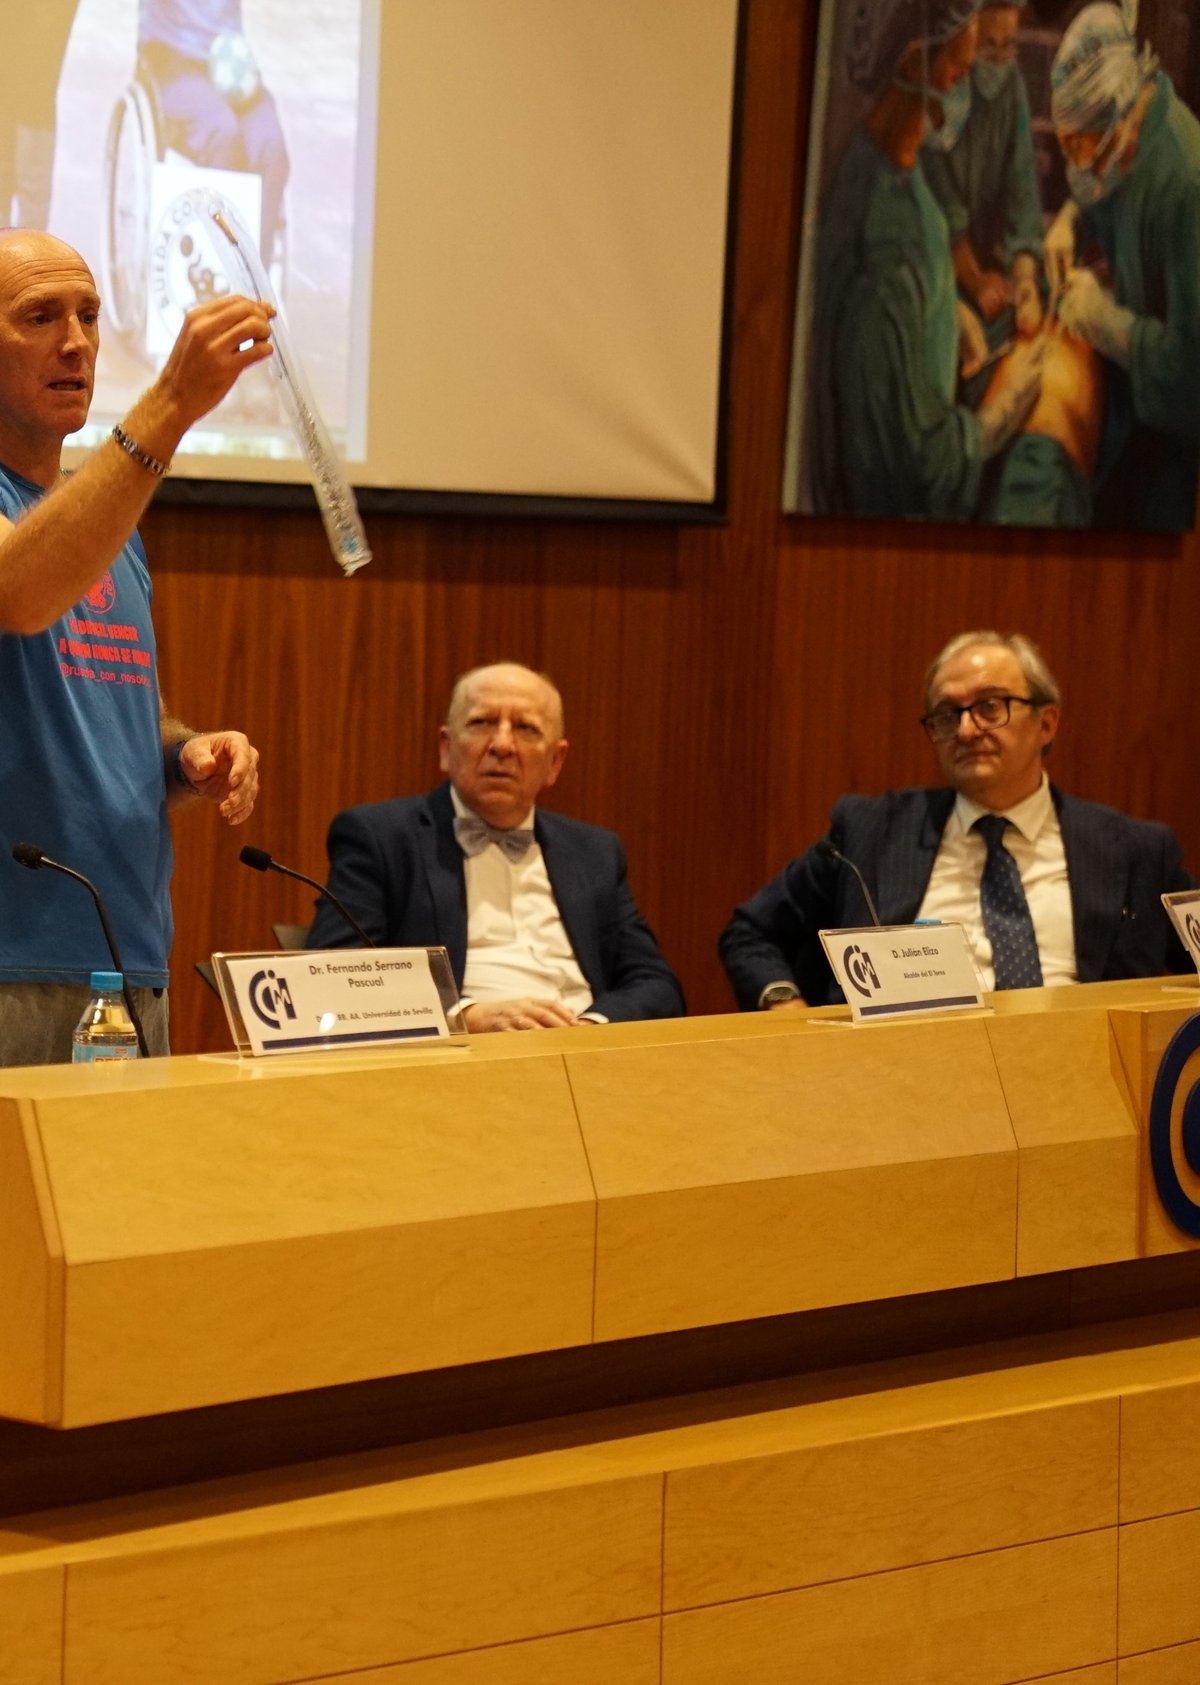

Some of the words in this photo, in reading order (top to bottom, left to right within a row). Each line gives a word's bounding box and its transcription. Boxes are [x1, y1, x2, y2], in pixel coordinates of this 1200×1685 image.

[891, 950, 901, 959] D.
[901, 947, 922, 958] Julián
[309, 965, 324, 976] Dr.
[326, 962, 372, 975] Fernando
[375, 960, 412, 972] Serrano
[348, 976, 384, 988] Pascual
[363, 1008, 400, 1019] Universidad
[403, 1008, 411, 1016] de
[412, 1006, 433, 1016] Sevilla
